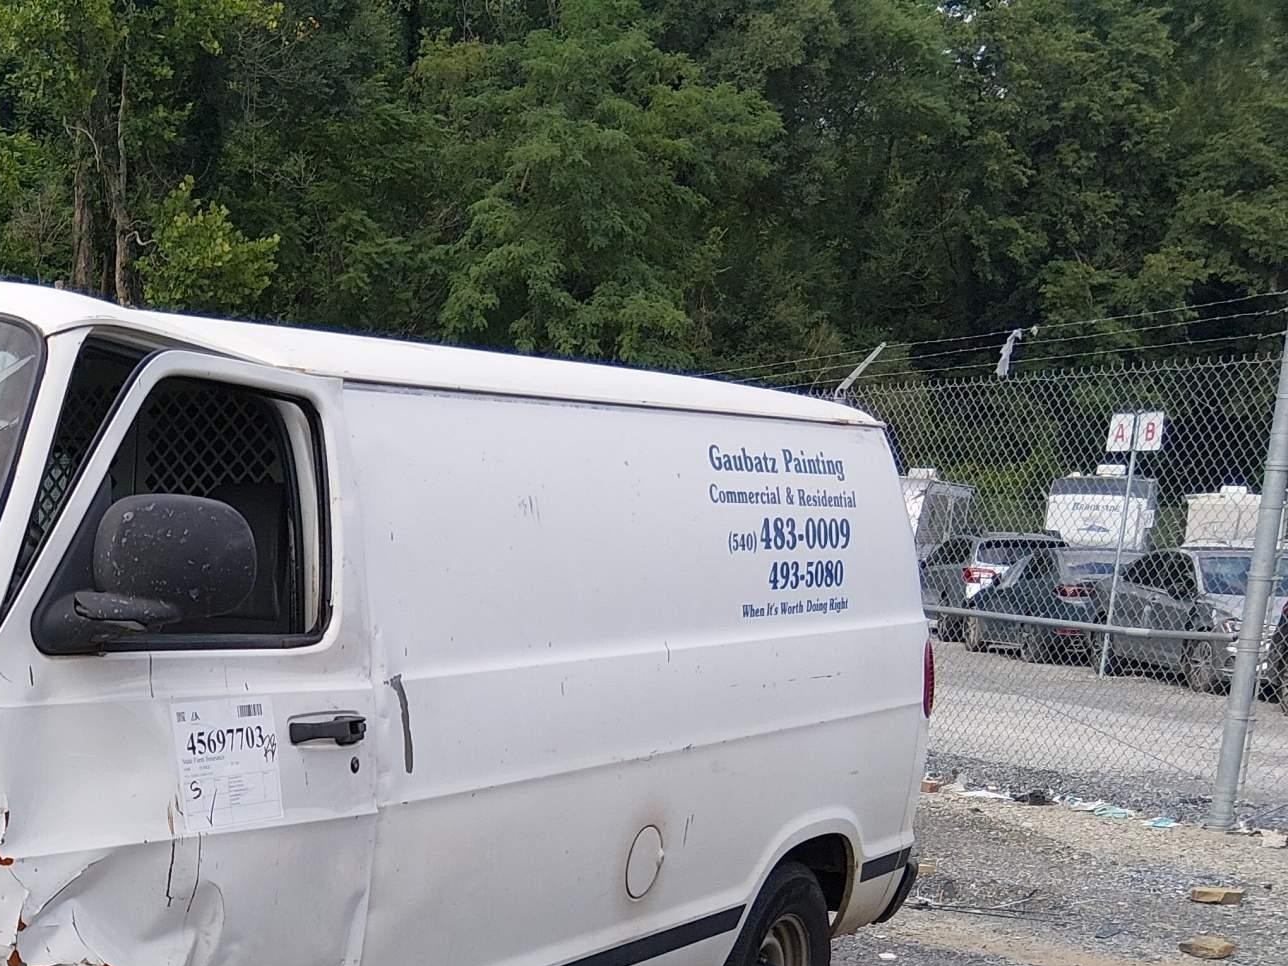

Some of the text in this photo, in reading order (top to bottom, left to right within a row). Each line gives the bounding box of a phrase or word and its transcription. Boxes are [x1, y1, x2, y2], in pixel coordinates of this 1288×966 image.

[1115, 423, 1125, 442] A
[1145, 421, 1155, 441] B
[708, 443, 845, 481] Gaubatz Painting
[709, 483, 856, 508] Commercial & Residential
[728, 517, 851, 554] (540) 483-0009
[768, 560, 844, 590] 493-5080
[742, 597, 849, 618] When It's Worth Doing Right
[187, 725, 265, 756] 45697703
